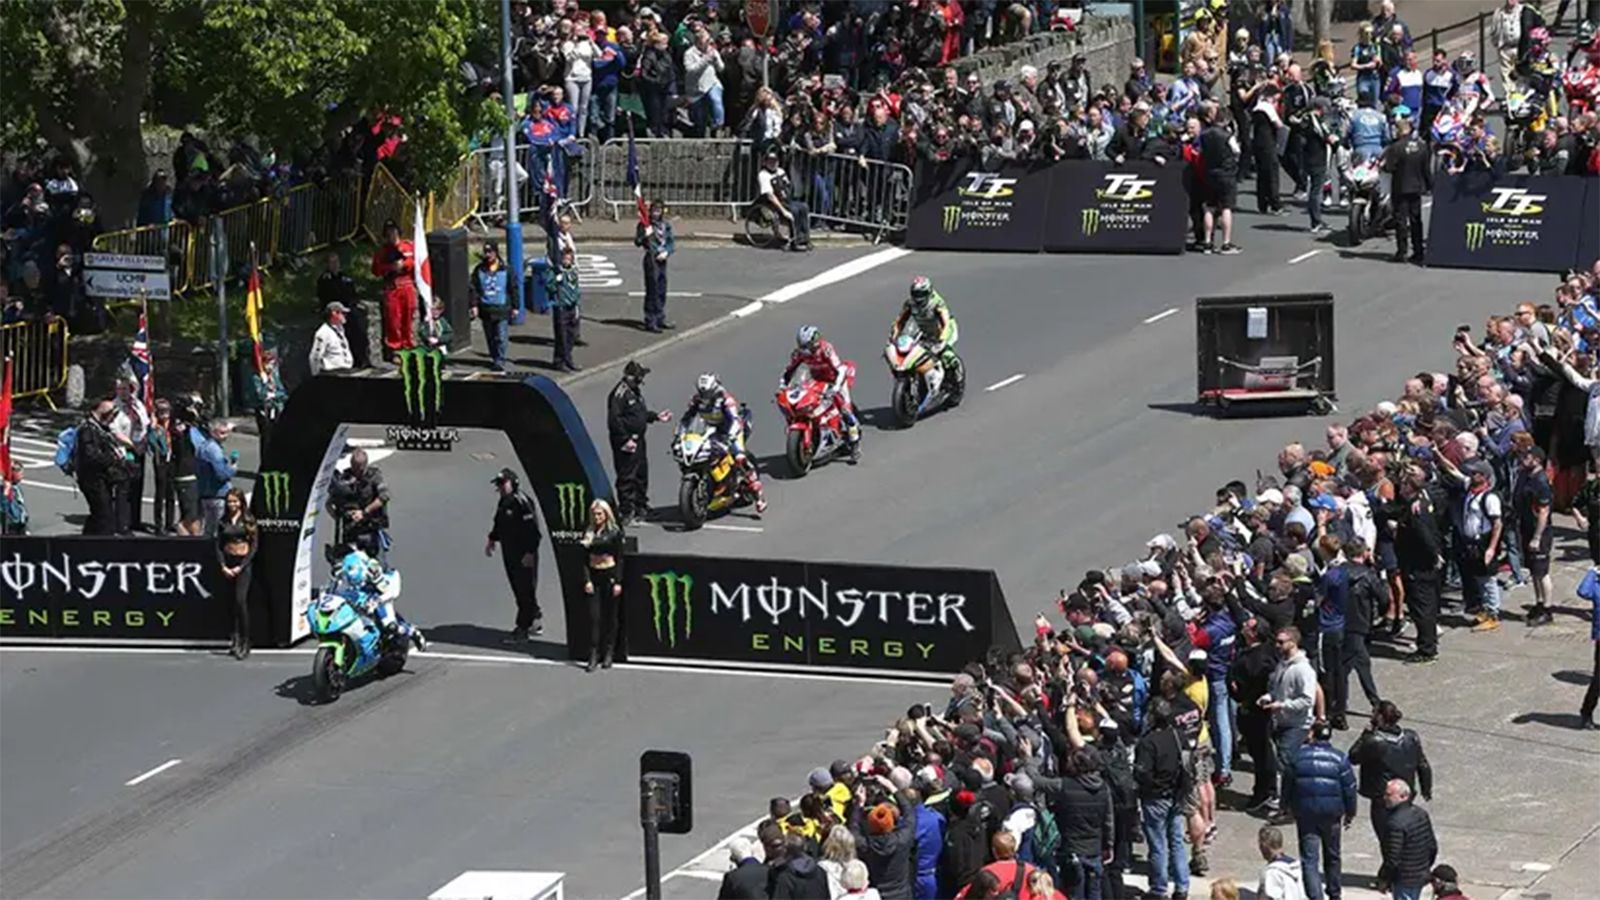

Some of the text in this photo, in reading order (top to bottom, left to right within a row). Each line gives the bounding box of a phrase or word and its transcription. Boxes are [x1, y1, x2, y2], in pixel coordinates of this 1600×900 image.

[966, 172, 1017, 198] TT
[1104, 173, 1157, 200] TT
[1490, 187, 1547, 216] TT
[961, 212, 1010, 221] MONSTER
[1100, 214, 1149, 223] MONSTER
[1485, 229, 1539, 240] MONSTER
[388, 428, 460, 441] MONSTER
[257, 520, 300, 528] MONSTER
[709, 576, 975, 632] MONSTER
[0, 609, 175, 626] ENERGY
[752, 633, 935, 659] ENERGY
